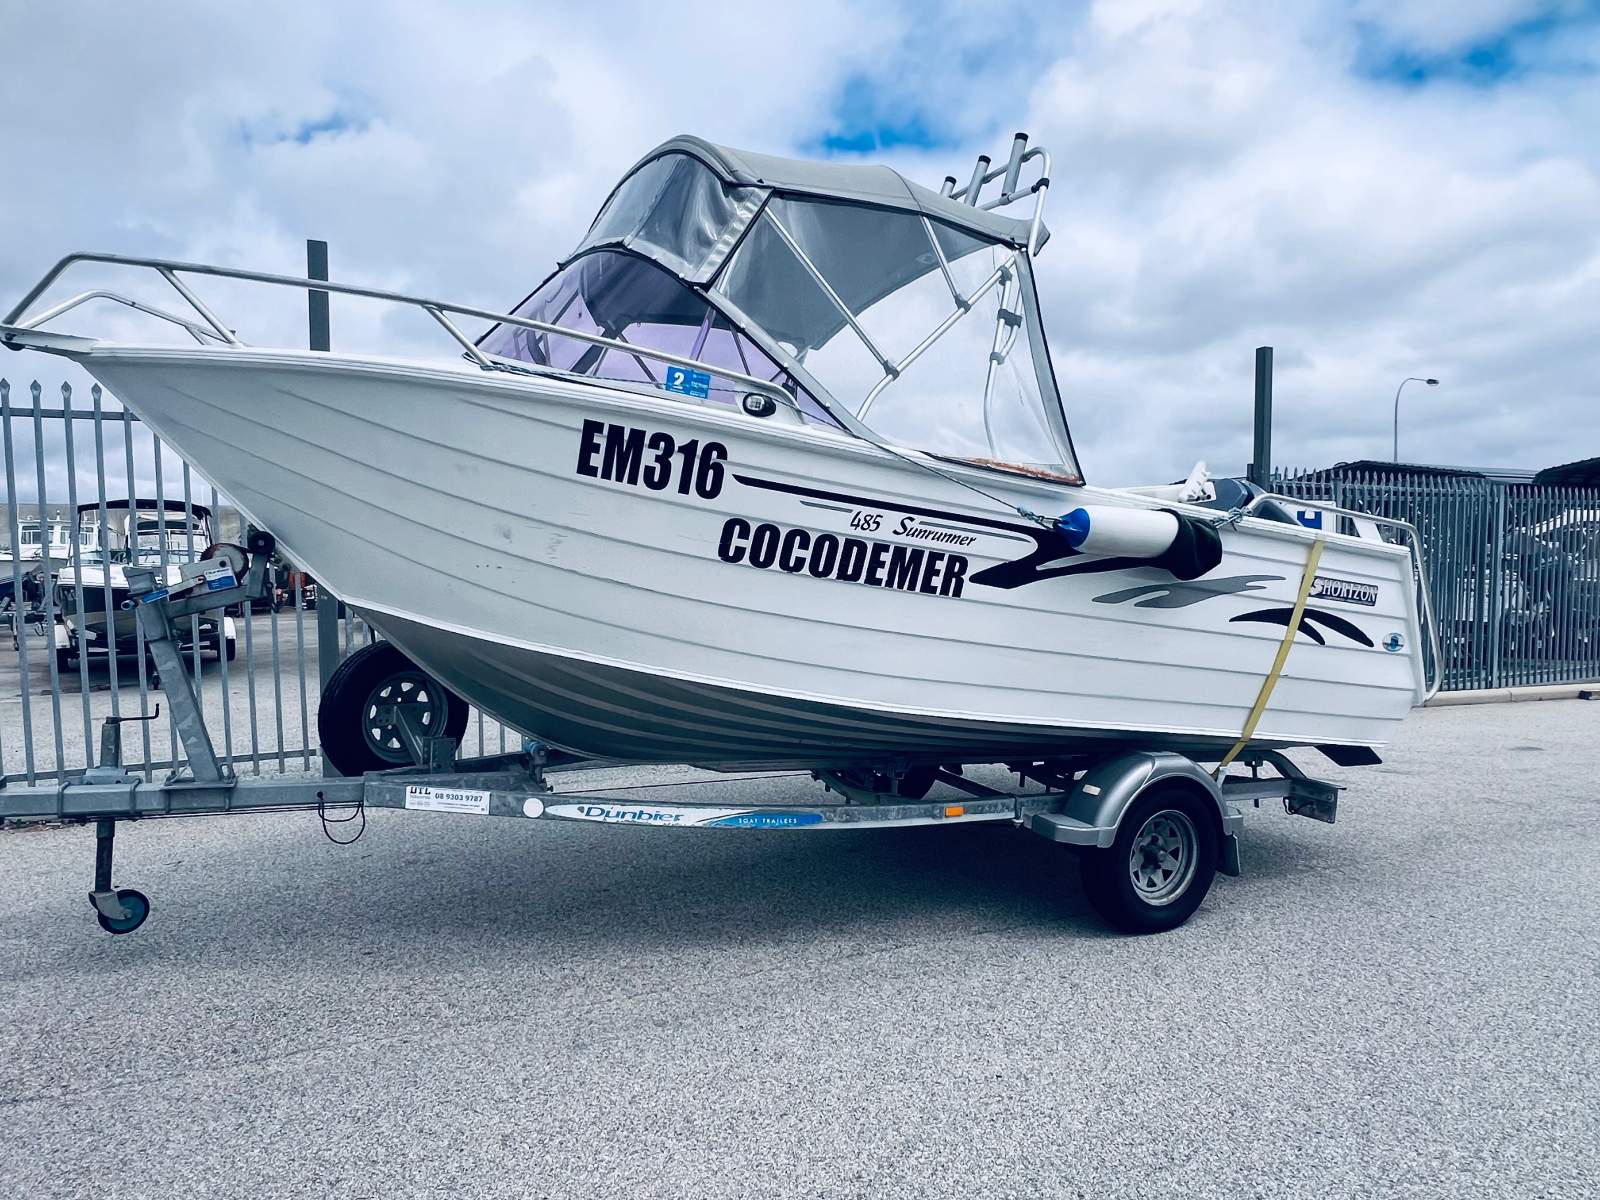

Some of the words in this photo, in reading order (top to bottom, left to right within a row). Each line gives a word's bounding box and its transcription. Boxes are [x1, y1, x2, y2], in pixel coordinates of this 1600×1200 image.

[673, 372, 685, 389] 2
[576, 418, 728, 500] EM316
[850, 511, 883, 532] 485
[892, 516, 977, 546] Sunrunner
[717, 517, 969, 598] COCODEMER
[1322, 579, 1378, 602] HORIZON
[585, 806, 684, 822] Dunbier
